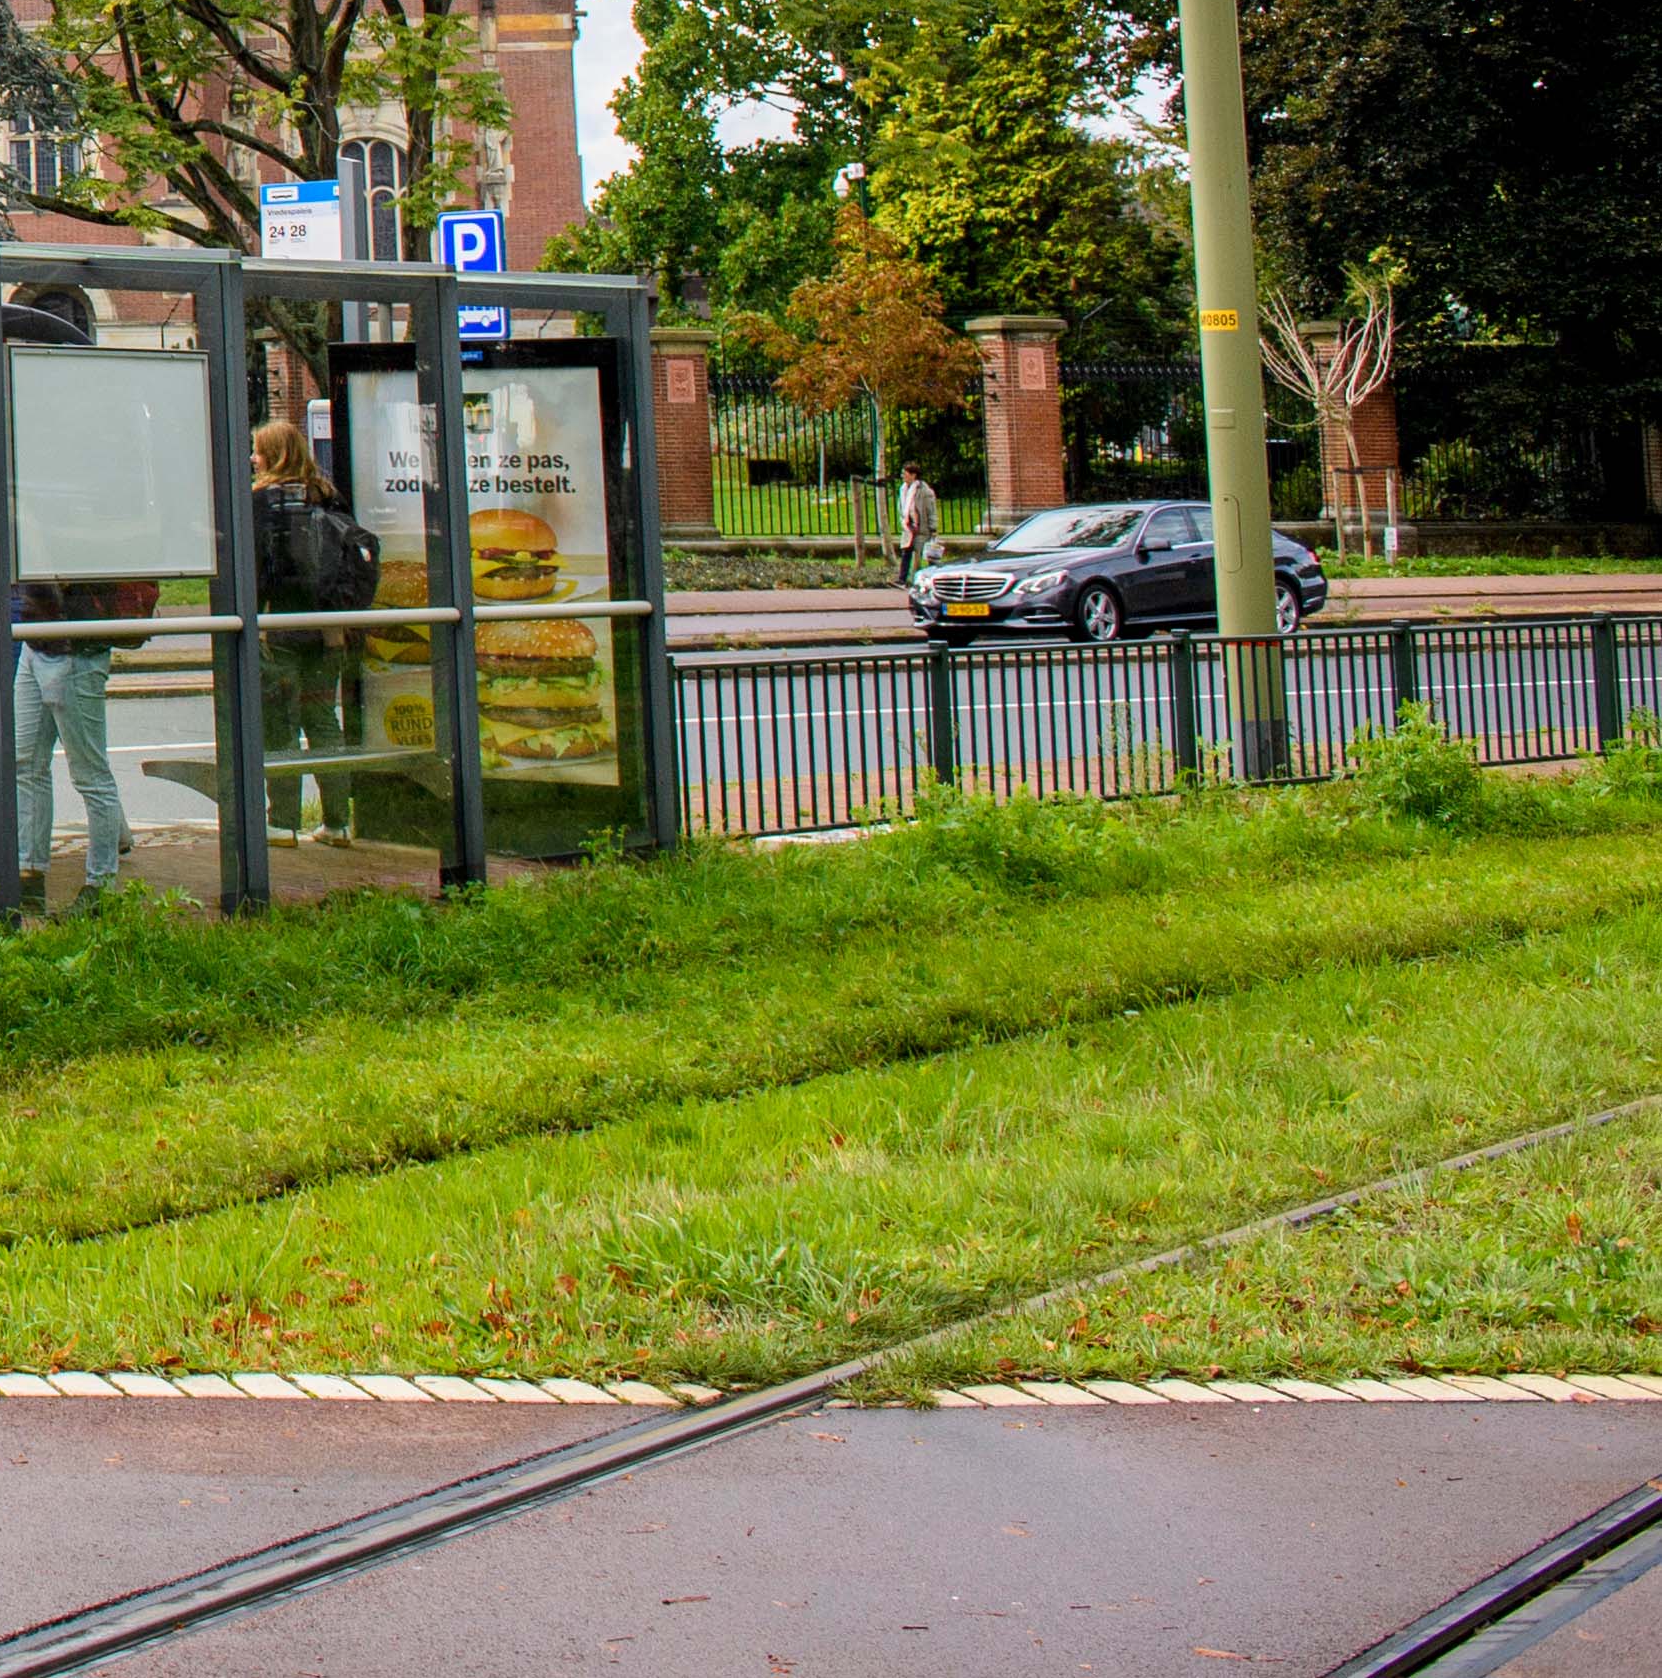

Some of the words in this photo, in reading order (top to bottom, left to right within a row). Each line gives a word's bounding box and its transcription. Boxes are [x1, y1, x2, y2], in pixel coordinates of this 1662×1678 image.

[268, 225, 285, 239] 24
[290, 224, 307, 237] 28
[453, 222, 487, 272] P
[498, 455, 521, 468] ze
[527, 454, 570, 472] pas,
[469, 479, 490, 493] ze
[495, 475, 577, 494] bestelt.
[390, 717, 433, 732] RUND
